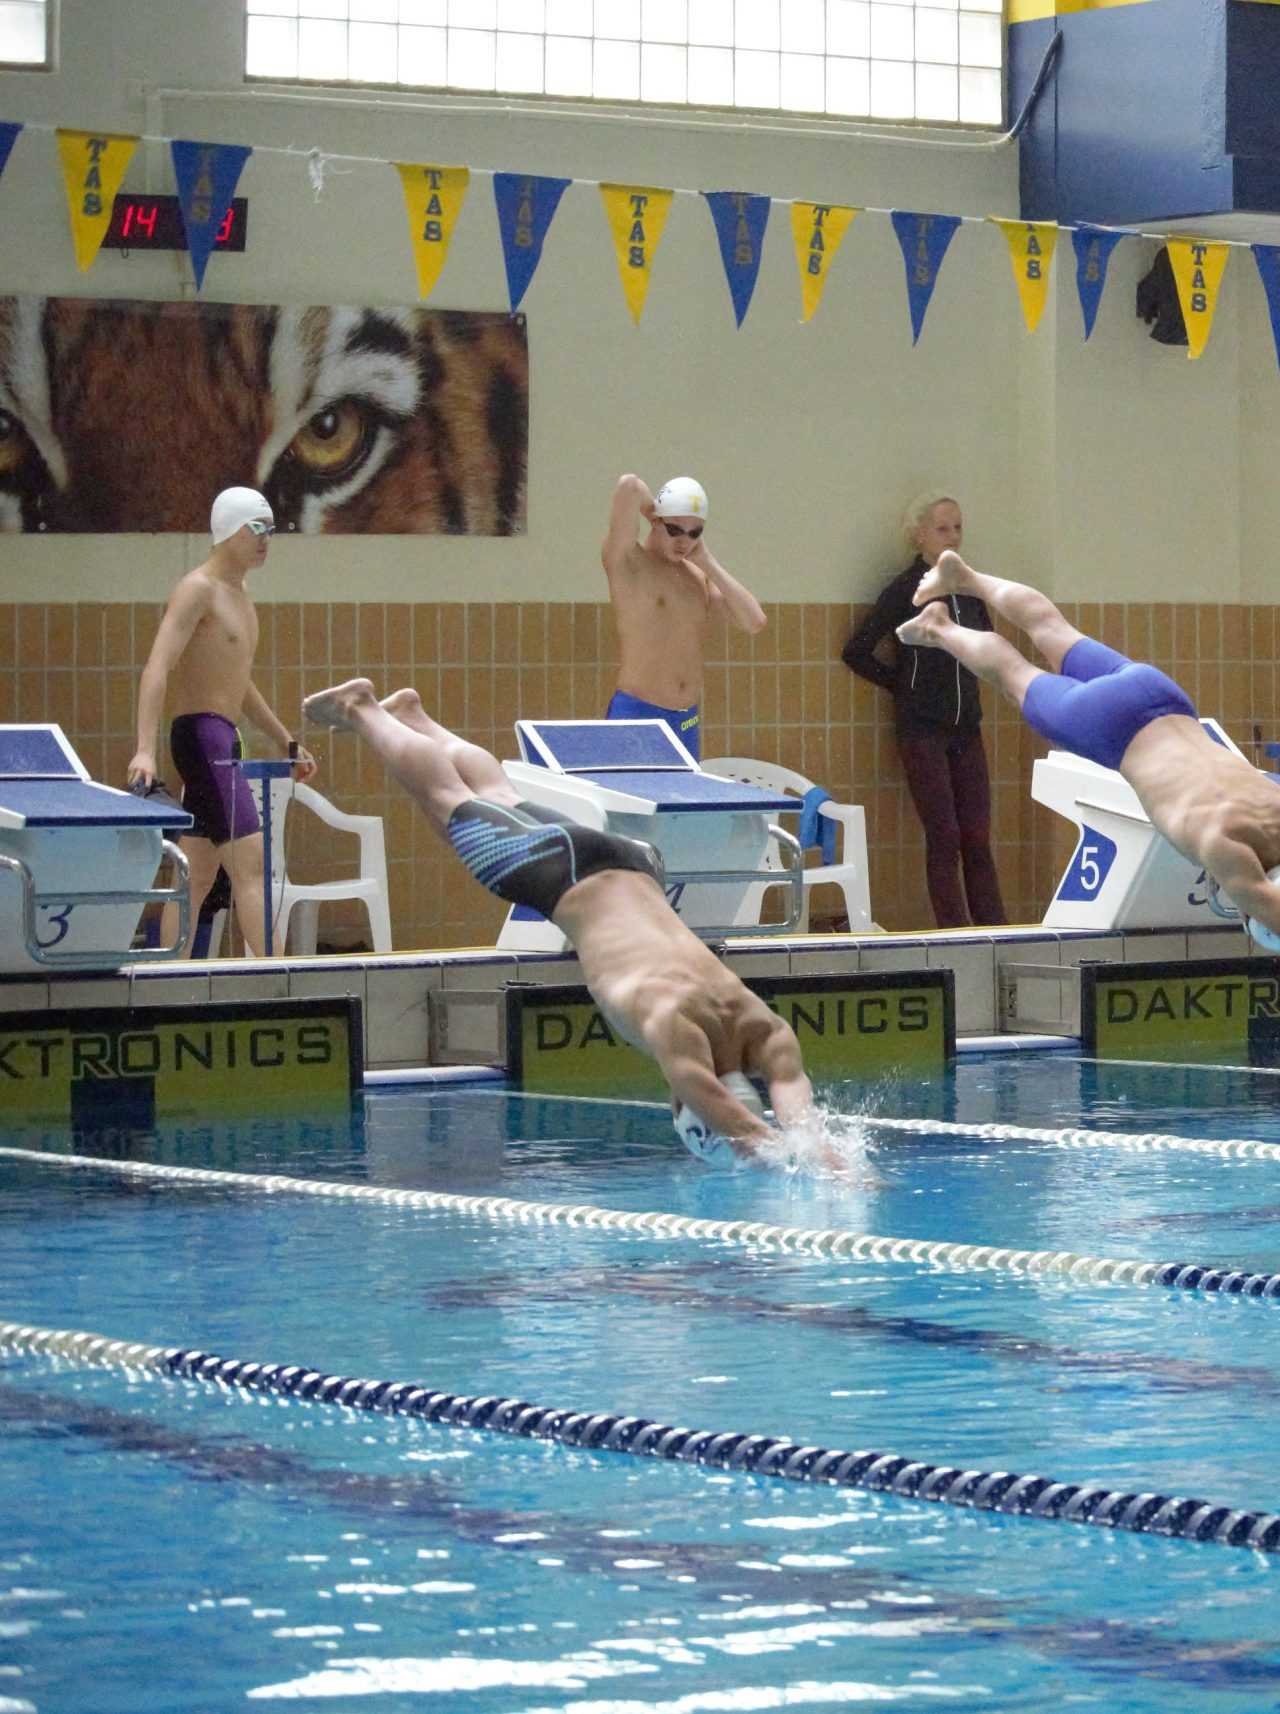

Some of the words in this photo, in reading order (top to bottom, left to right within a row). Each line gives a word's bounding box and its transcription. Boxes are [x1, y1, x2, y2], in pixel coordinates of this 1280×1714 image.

[83, 137, 107, 215] TAS
[424, 168, 443, 242] TAS
[122, 204, 158, 239] 14
[628, 194, 648, 269] TAS
[807, 204, 831, 276] TAS
[1191, 245, 1207, 313] TAS
[1080, 846, 1100, 891] 5
